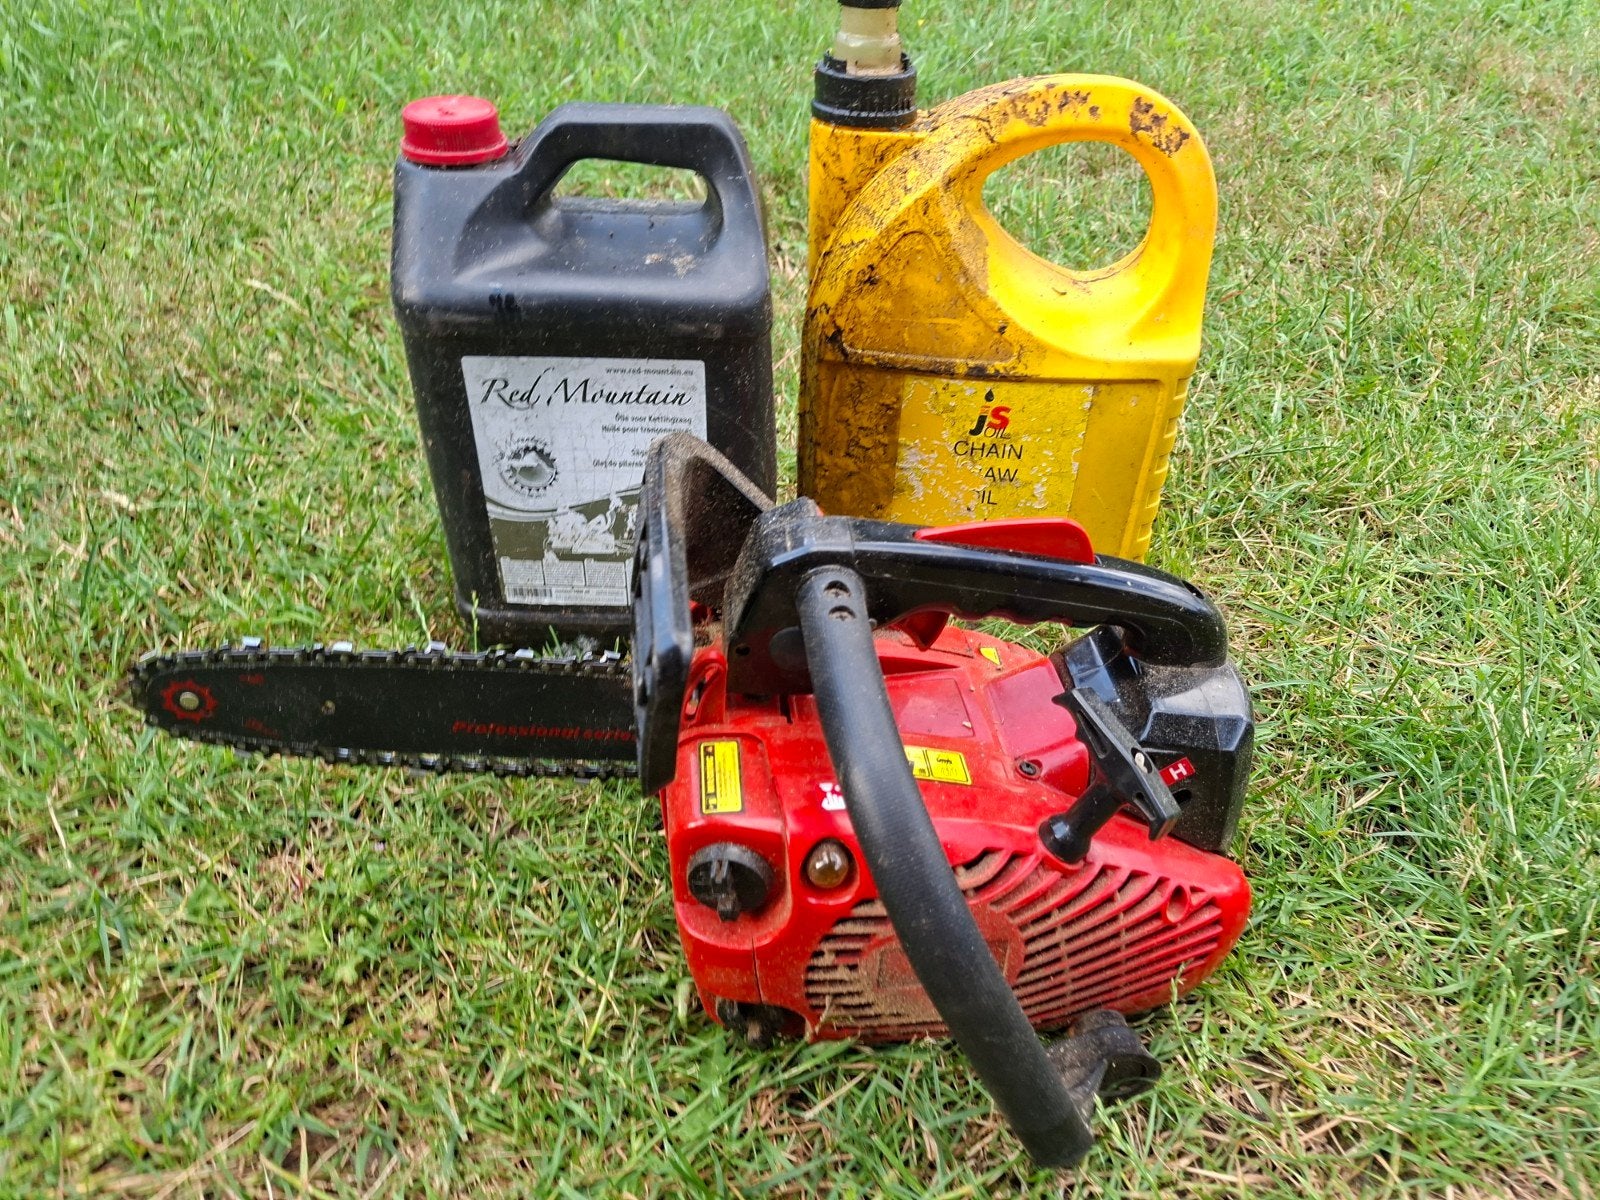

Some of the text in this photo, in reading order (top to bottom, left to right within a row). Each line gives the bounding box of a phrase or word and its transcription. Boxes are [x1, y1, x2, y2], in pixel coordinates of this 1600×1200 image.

[480, 366, 693, 411] Red Mountain
[983, 426, 1011, 439] OIL
[953, 440, 1024, 460] CHAIN
[977, 466, 1019, 483] AW
[974, 488, 998, 506] IL
[452, 720, 581, 740] Professional
[1168, 763, 1188, 781] H
